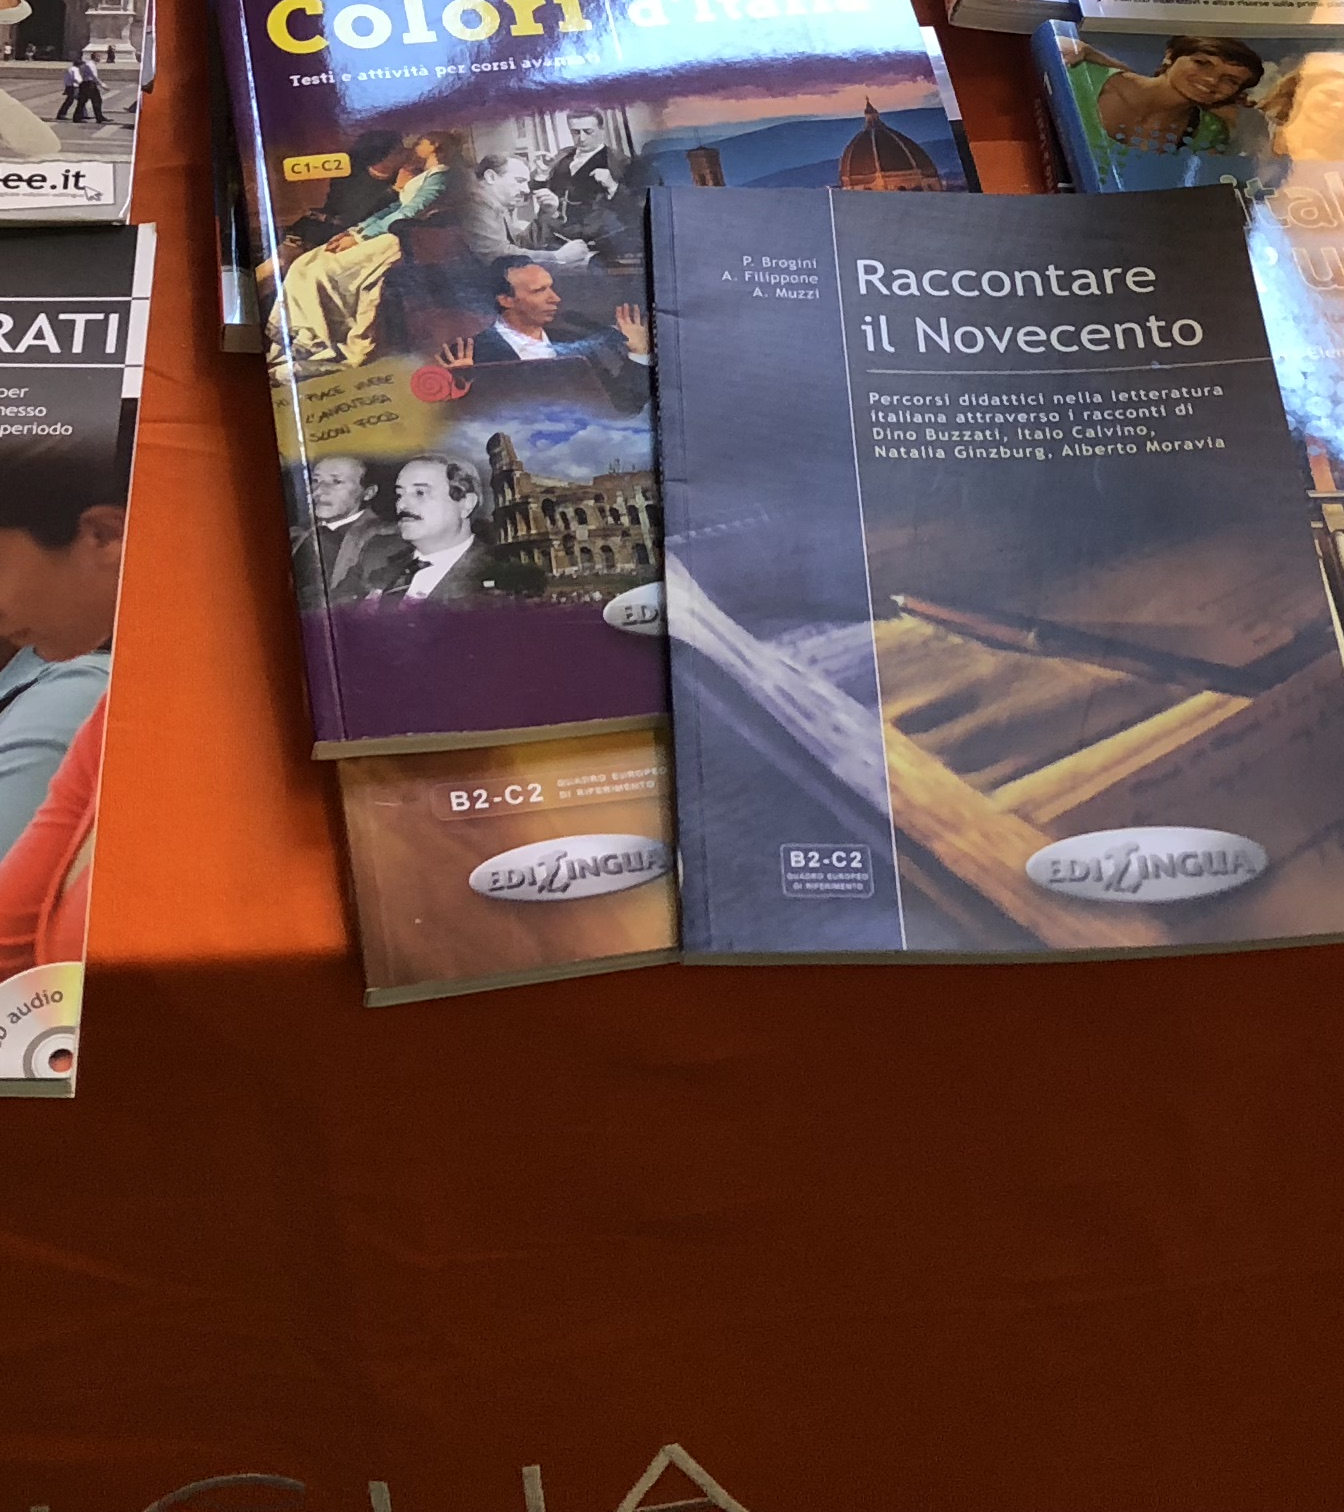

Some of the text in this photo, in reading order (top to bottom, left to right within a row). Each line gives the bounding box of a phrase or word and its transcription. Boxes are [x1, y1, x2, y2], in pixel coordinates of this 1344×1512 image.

[357, 55, 517, 82] attività corsi
[292, 158, 344, 174] C1-C2
[744, 271, 818, 286] Filippone
[856, 259, 1156, 298] Raccontare
[862, 316, 1204, 355] il Novecento
[869, 384, 1224, 407] Percorsi didattici letteratura
[870, 405, 1167, 424] italiana attraverso racconti
[0, 421, 72, 441] periodo
[925, 424, 1156, 444] Buzzati, Calvino,
[874, 436, 1225, 463] Natalia Ginzburg, Alberto Moravia
[450, 783, 544, 812] B2-C2
[790, 851, 862, 869] B2-C2
[6, 989, 64, 1025] audio
